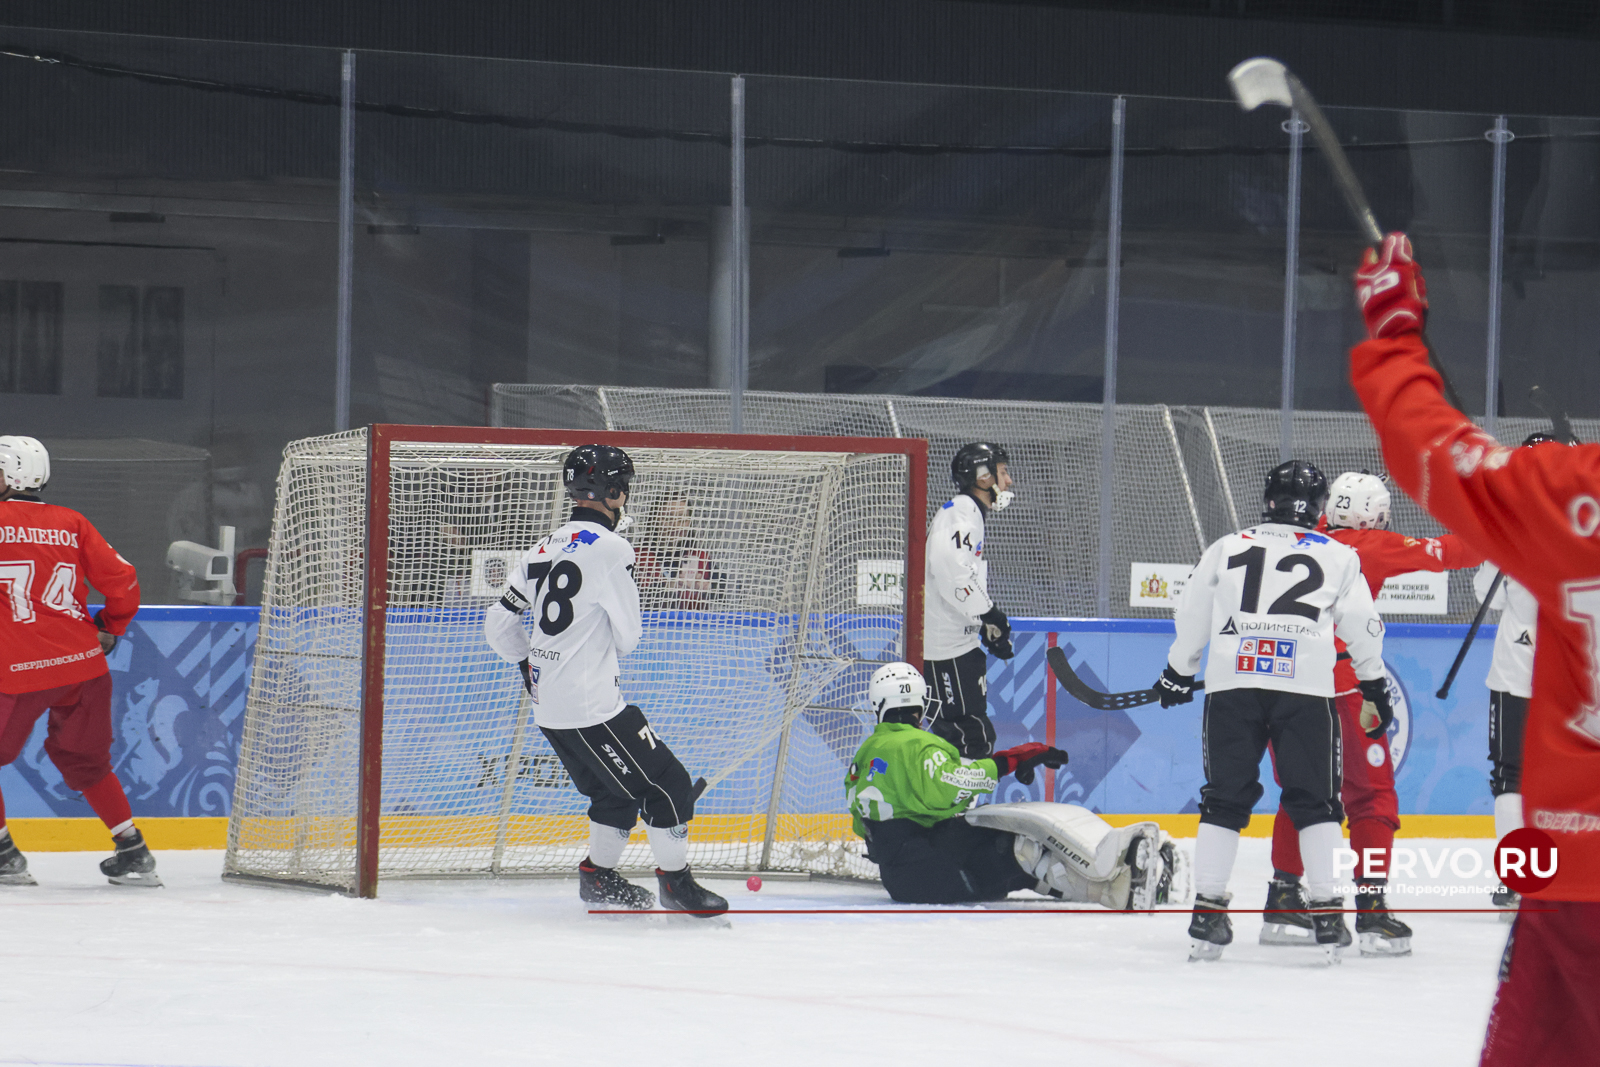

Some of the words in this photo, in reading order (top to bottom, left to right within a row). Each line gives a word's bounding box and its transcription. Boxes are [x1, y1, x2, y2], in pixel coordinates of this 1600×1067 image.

[566, 468, 575, 481] 78
[1294, 500, 1307, 513] 12
[1336, 495, 1351, 509] 23
[952, 530, 973, 551] 14
[0, 559, 85, 624] 74
[1227, 545, 1325, 622] 12
[527, 559, 583, 637] 78
[10, 652, 84, 672] СВЕРДЛОВСКАЯ
[899, 683, 911, 694] 20
[600, 743, 631, 776] STEX
[1046, 835, 1091, 870] BAUER
